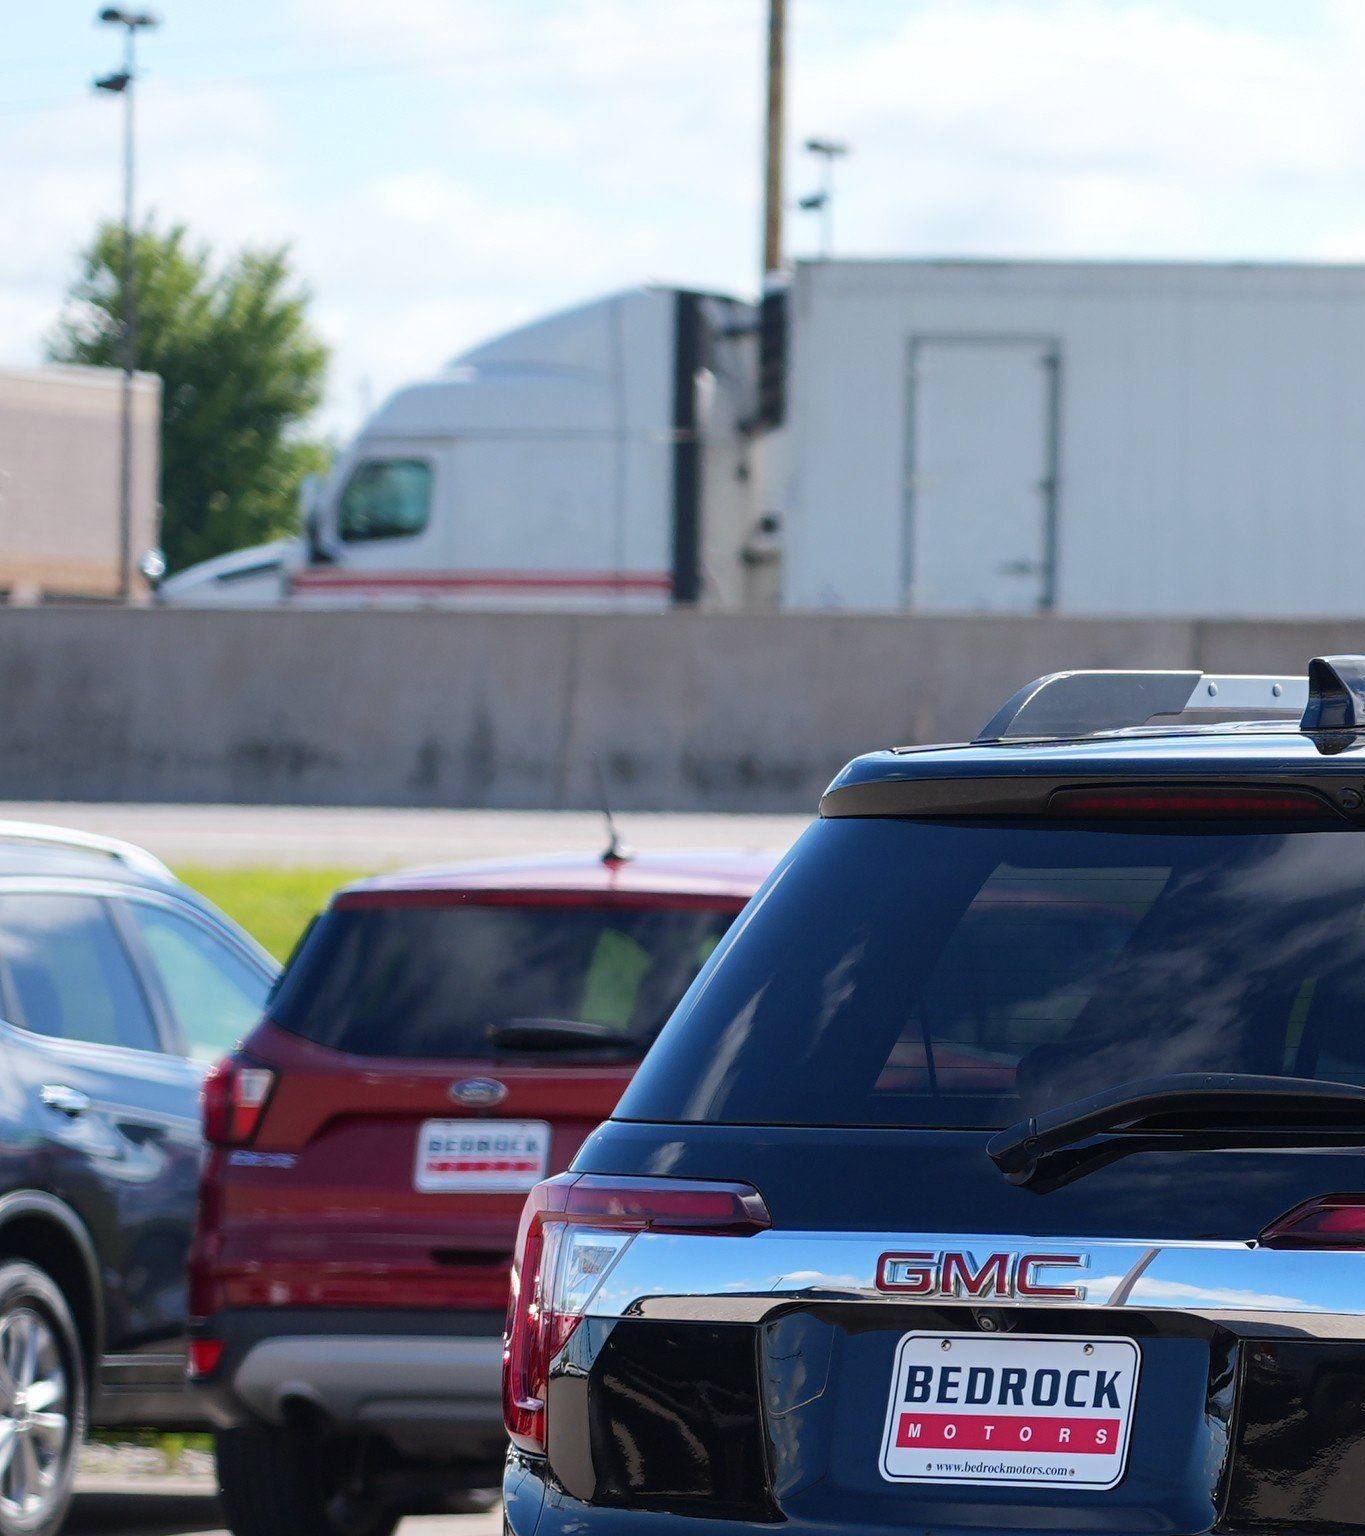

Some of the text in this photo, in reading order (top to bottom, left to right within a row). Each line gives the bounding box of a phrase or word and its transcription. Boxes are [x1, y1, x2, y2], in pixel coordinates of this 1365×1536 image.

[874, 1250, 1090, 1300] GMC
[903, 1365, 1122, 1409] BEDROCK
[907, 1423, 1108, 1444] MOTORS
[935, 1460, 1068, 1477] www.bedrockmotors.com
